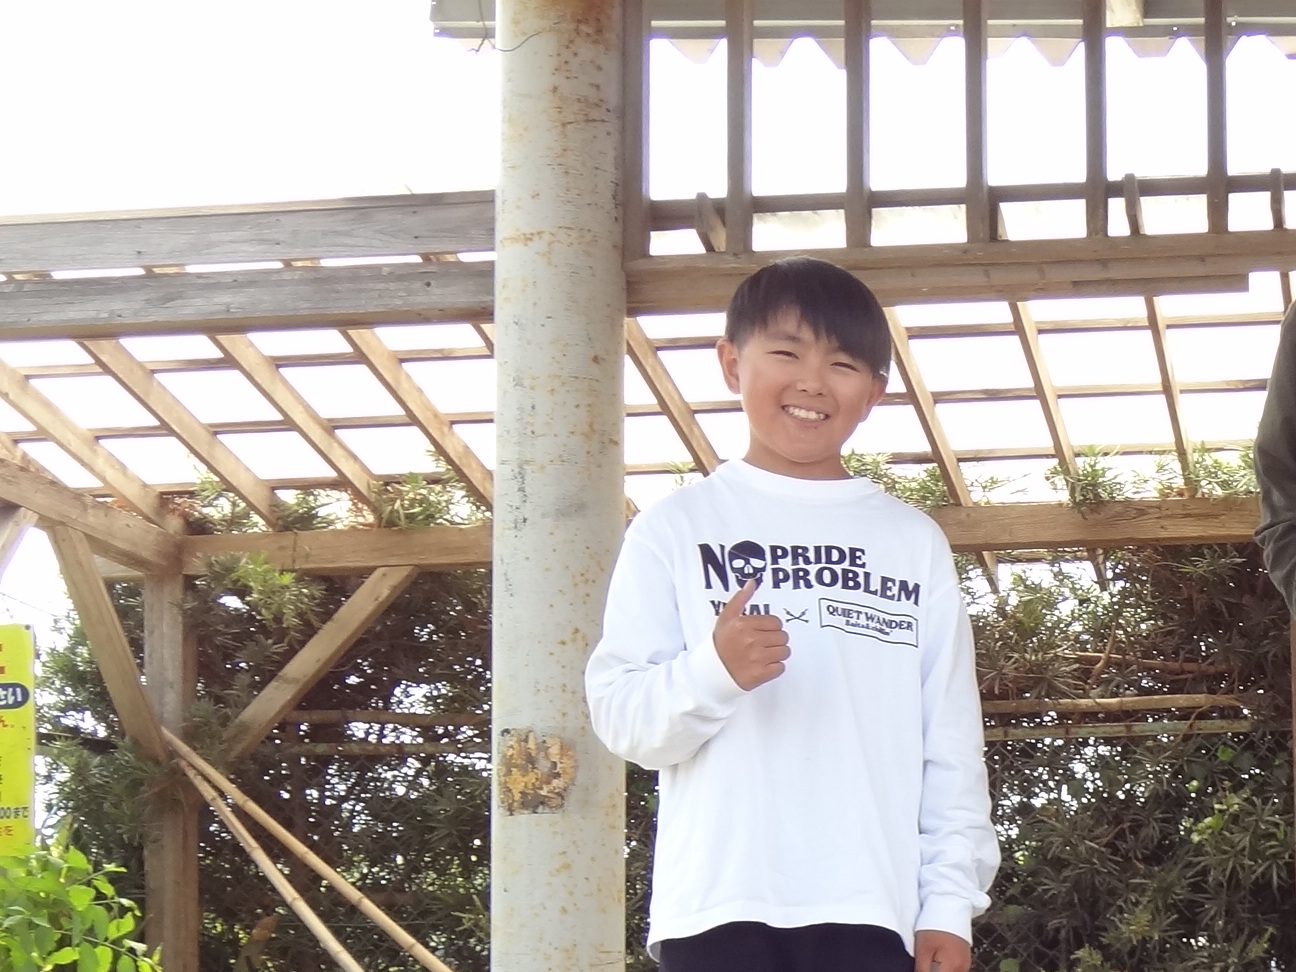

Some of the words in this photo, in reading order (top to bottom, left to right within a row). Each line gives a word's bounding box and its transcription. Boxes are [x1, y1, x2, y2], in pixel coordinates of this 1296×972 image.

[769, 544, 866, 568] PRIDE
[771, 567, 921, 607] PROBLEM
[827, 604, 862, 620] QUIET
[864, 612, 914, 632] WANDER
